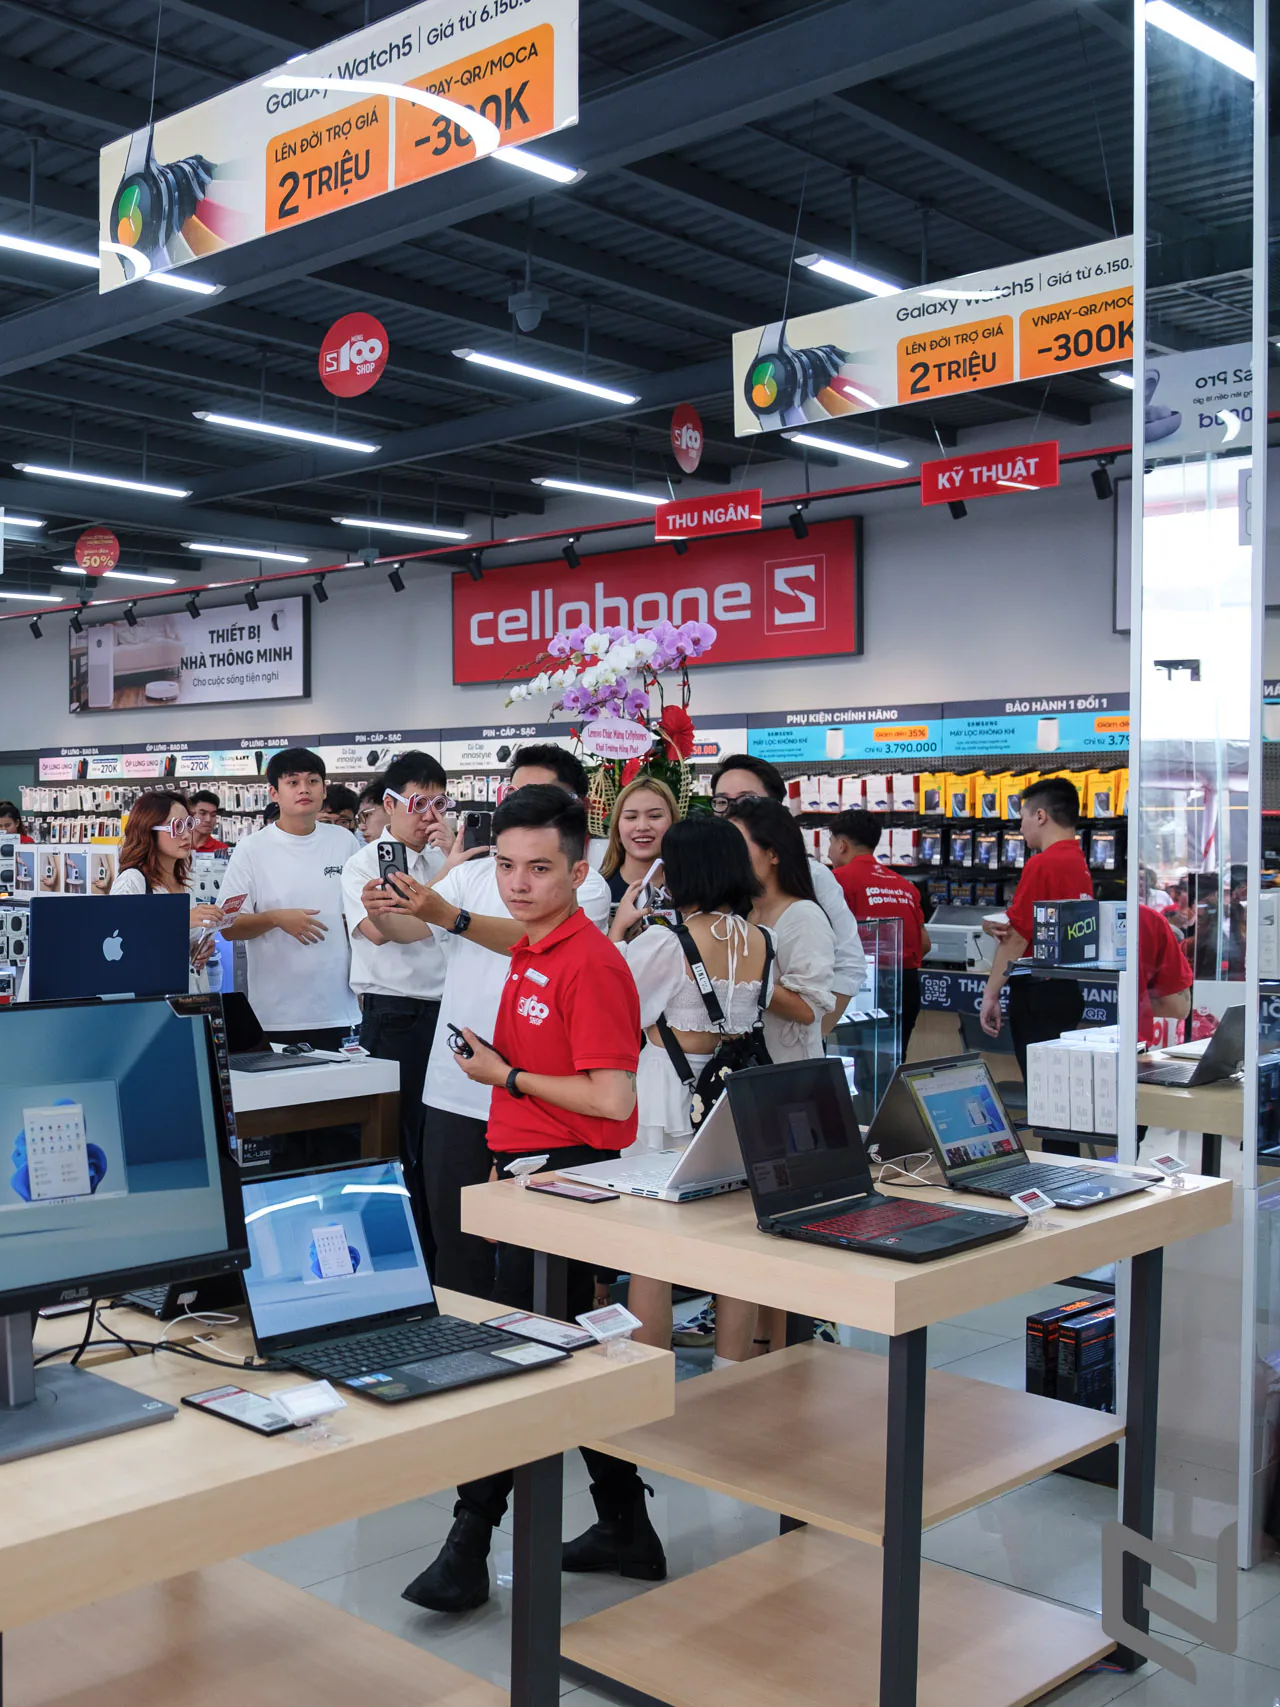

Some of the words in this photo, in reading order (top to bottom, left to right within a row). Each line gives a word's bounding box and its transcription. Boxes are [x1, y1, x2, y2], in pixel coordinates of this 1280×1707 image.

[337, 33, 413, 81] Watch5
[426, 18, 455, 46] Giá
[458, 9, 477, 32] từ
[480, 0, 532, 22] 6.150.
[275, 141, 297, 163] LÊN
[300, 130, 322, 154] ĐỜI
[326, 120, 352, 146] TRỢ
[355, 105, 379, 130] GIÁ
[413, 42, 539, 107] PAY-QR/MOCA
[278, 170, 300, 220] 2
[303, 149, 370, 200] TRIỆU
[896, 298, 959, 322] Galaxy
[1046, 272, 1072, 288] Giá
[1076, 266, 1092, 280] từ
[1095, 257, 1134, 277] 6.150.
[905, 341, 927, 356] LÊN
[982, 322, 1004, 339] GIÁ
[356, 362, 375, 375] SHOP
[910, 361, 931, 395] 2
[933, 351, 997, 382] TRIỆU
[937, 466, 963, 490] KỸ
[970, 457, 1039, 486] THUẬT
[666, 508, 698, 531] THU
[702, 502, 750, 526] NGÂN
[81, 555, 114, 568] 50%
[208, 621, 245, 644] THIẾT
[248, 624, 261, 643] BỊ
[180, 651, 207, 671] NHÀ
[209, 648, 254, 670] THÔNG
[256, 646, 293, 664] MINH
[1005, 700, 1030, 713] BẢO
[1032, 698, 1067, 712] HÀNH
[1069, 699, 1075, 710] 1
[1076, 694, 1100, 709] ĐỔI
[1101, 698, 1108, 708] 1
[786, 713, 808, 726] PHỤ
[809, 711, 832, 724] KIỆN
[833, 710, 867, 722] CHÍNH
[868, 709, 898, 721] HÃNG
[483, 728, 496, 737] PIN
[499, 726, 515, 737] CÁP
[907, 728, 926, 738] 35%
[884, 742, 938, 754] 3.790.000
